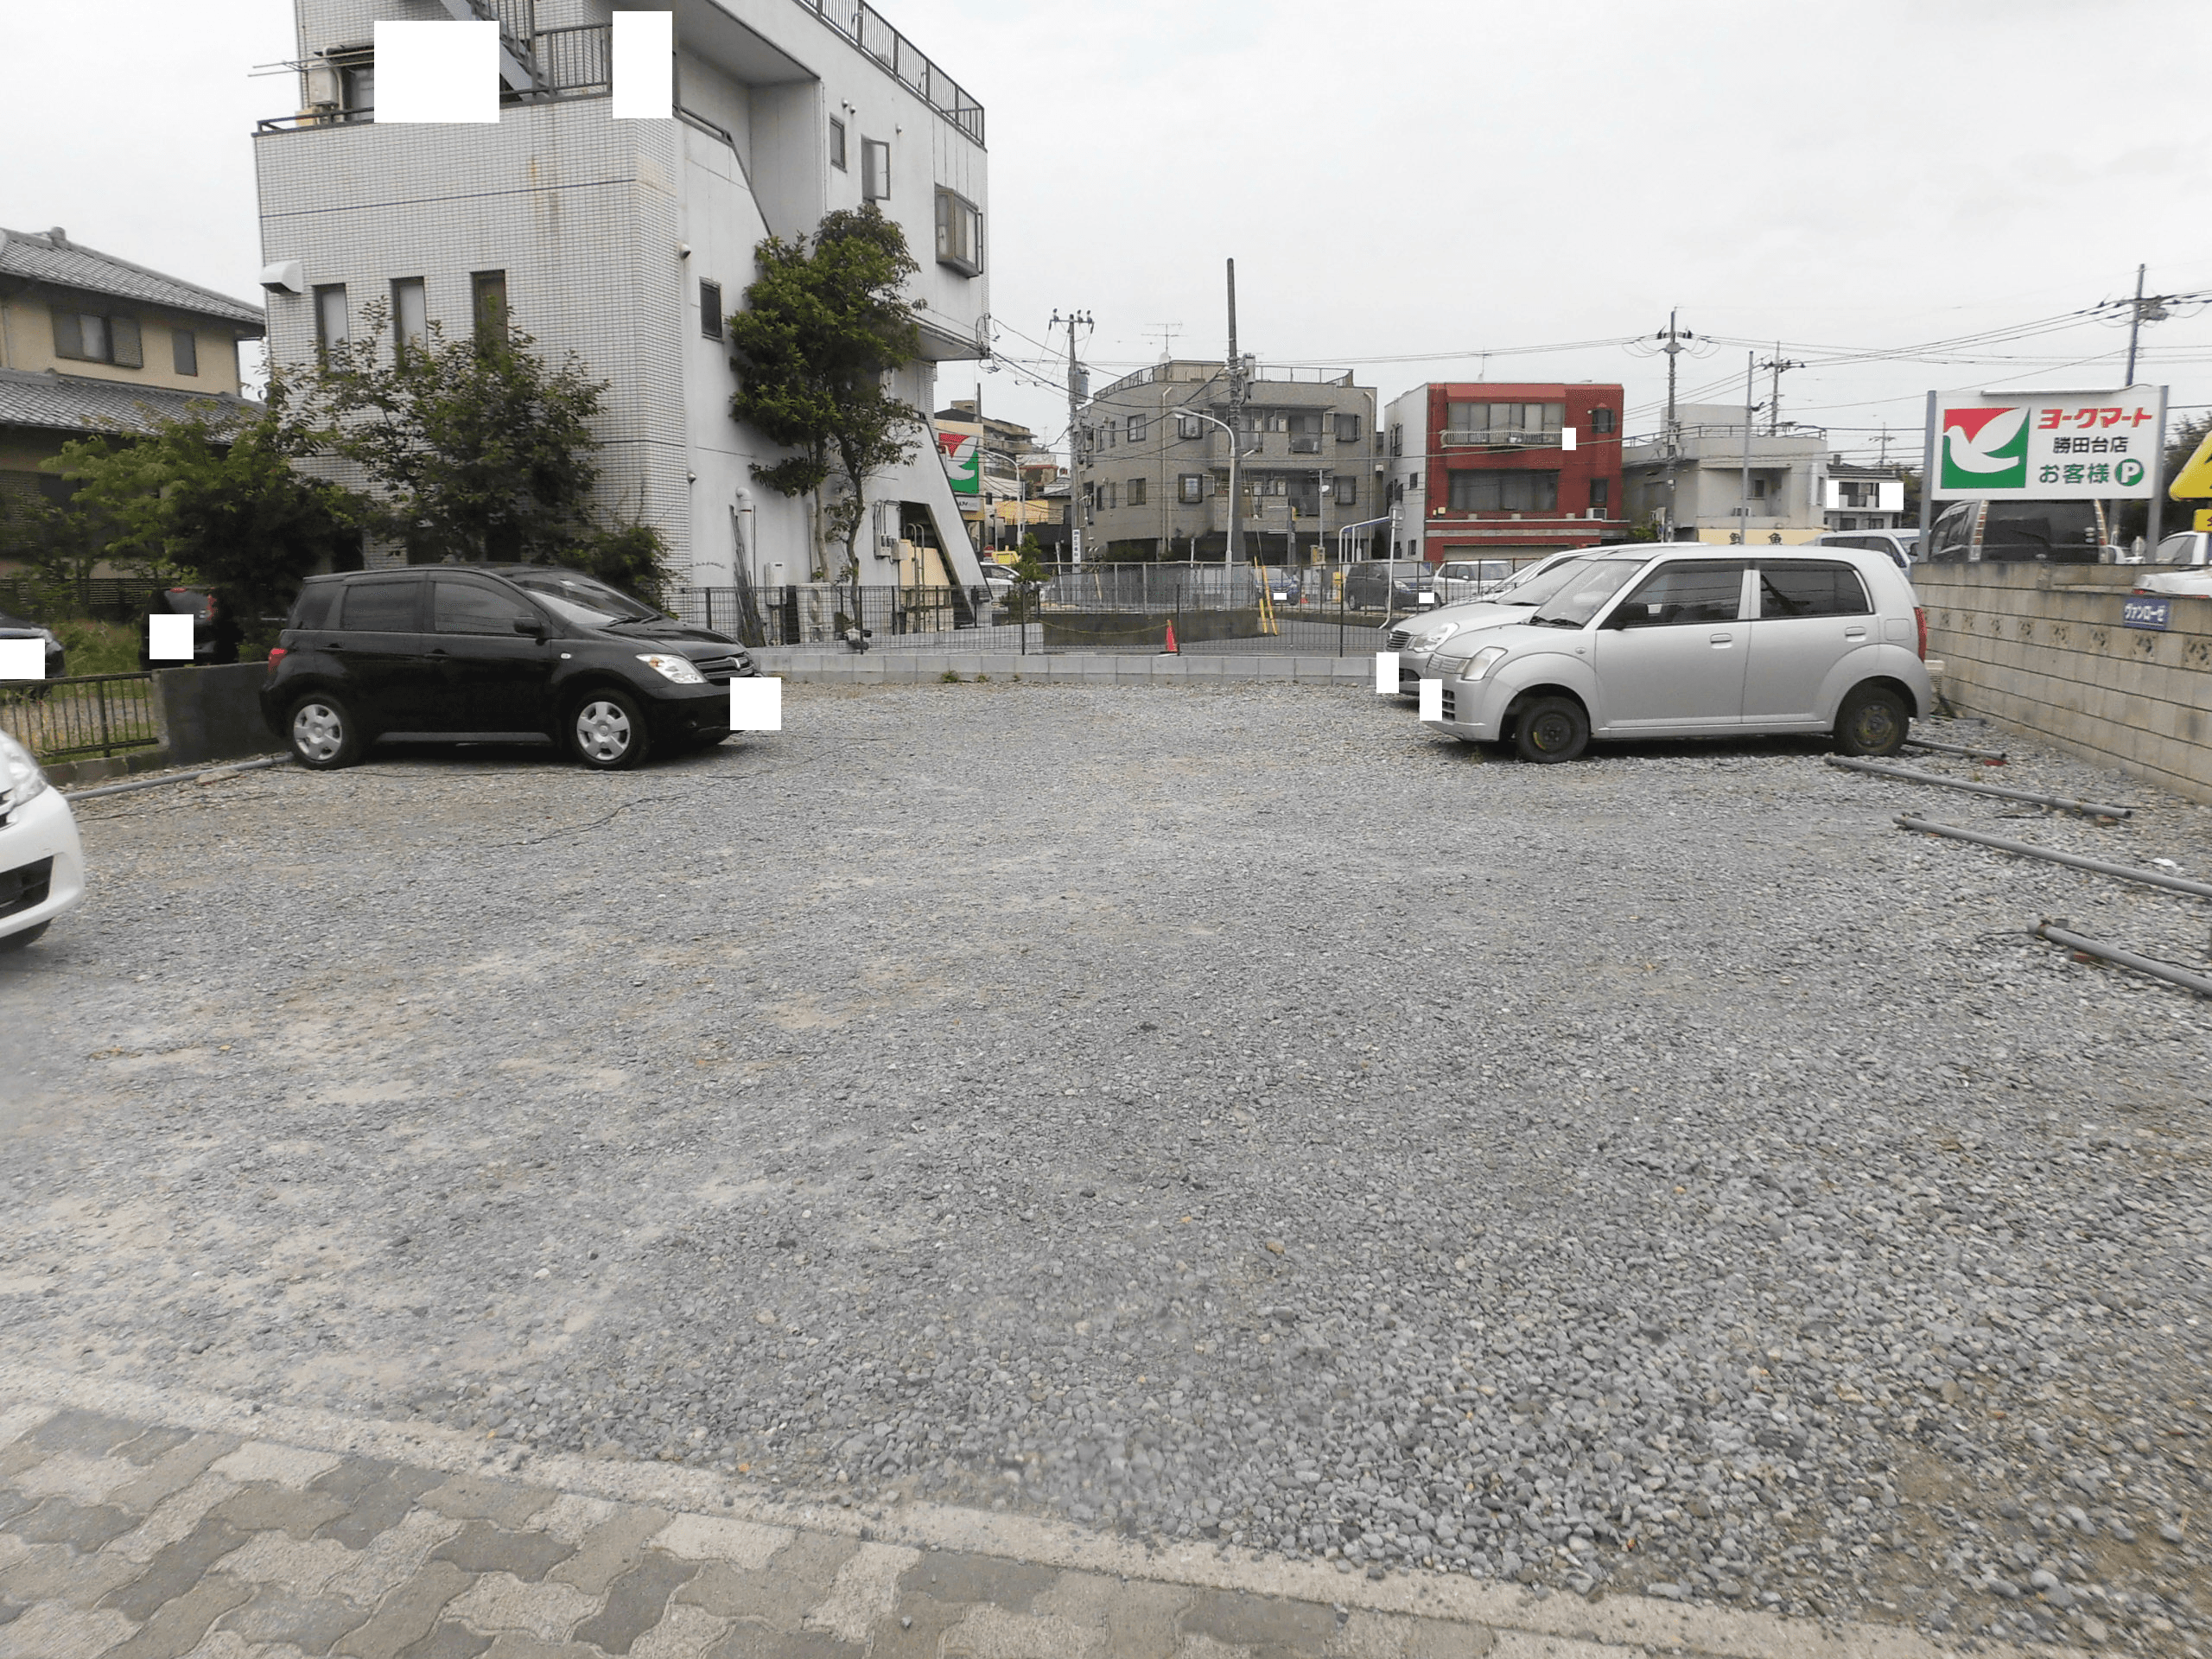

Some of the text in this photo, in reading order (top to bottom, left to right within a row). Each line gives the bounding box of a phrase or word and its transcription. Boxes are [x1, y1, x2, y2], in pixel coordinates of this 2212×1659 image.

[2037, 407, 2152, 429] ヨークマート
[2053, 436, 2129, 454] 勝田台店
[2039, 463, 2109, 484] お客様
